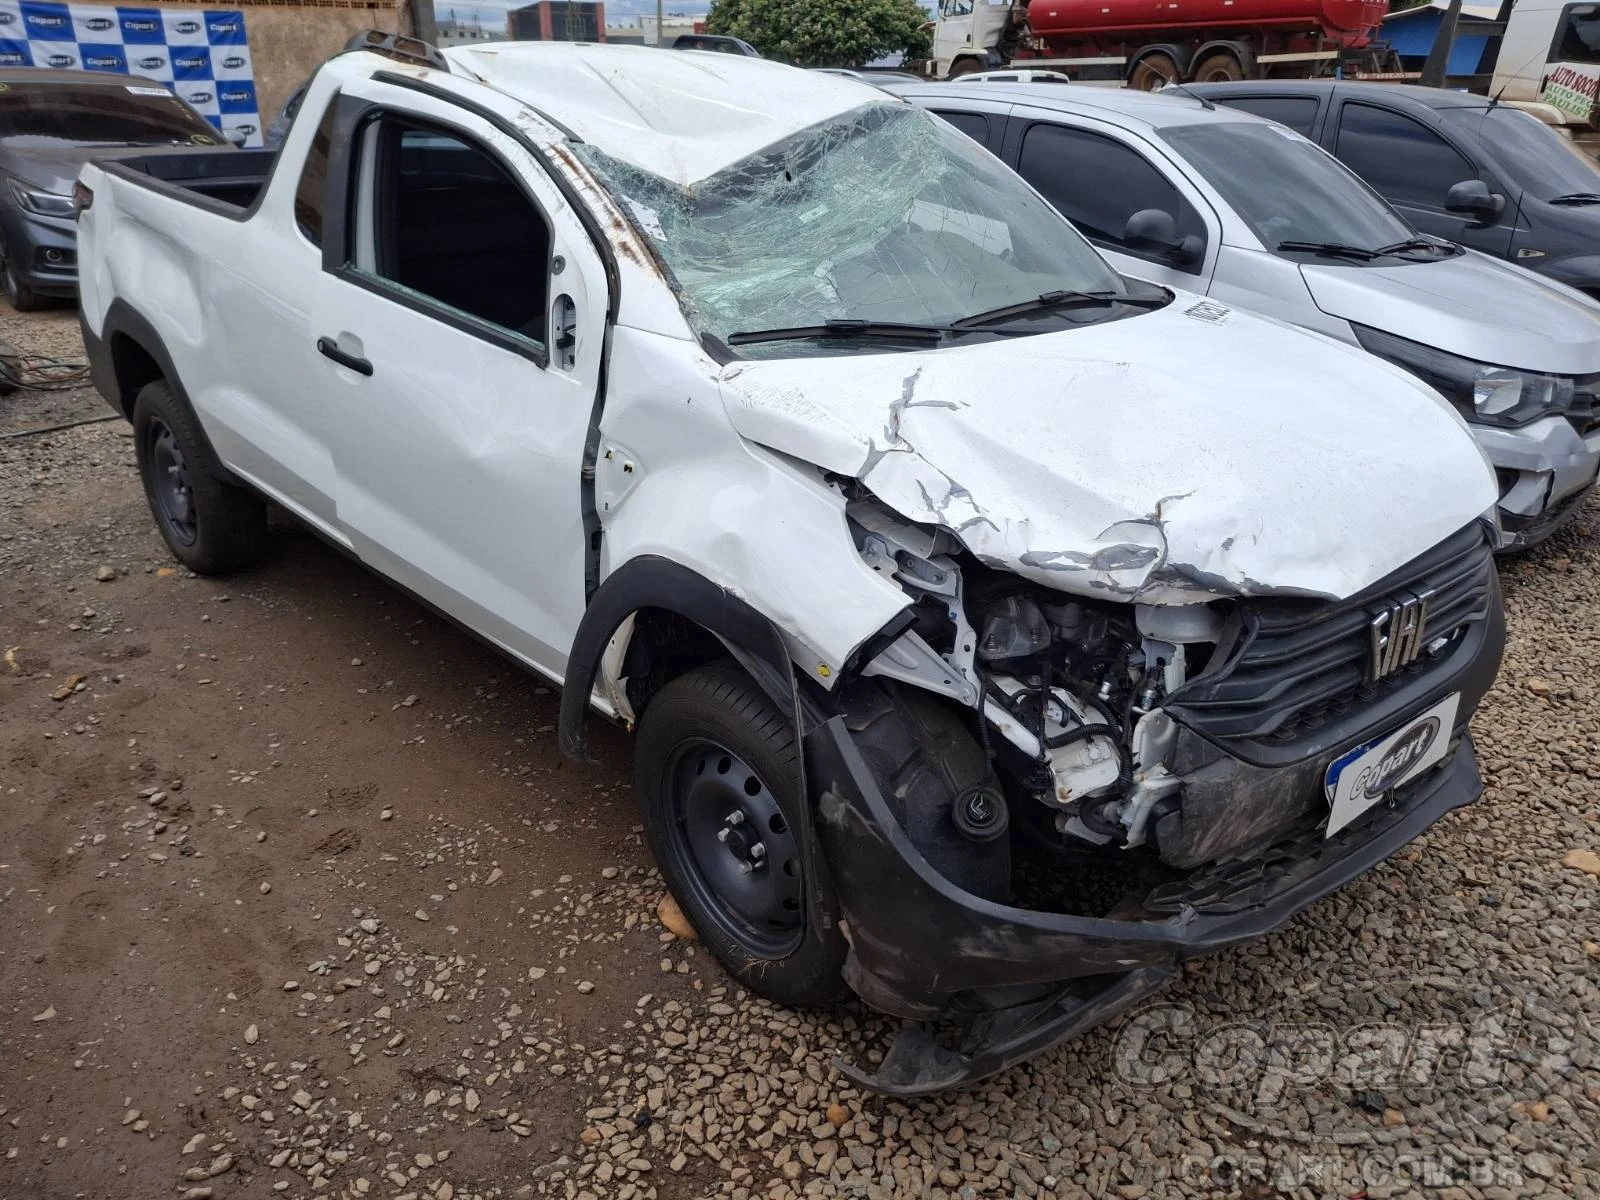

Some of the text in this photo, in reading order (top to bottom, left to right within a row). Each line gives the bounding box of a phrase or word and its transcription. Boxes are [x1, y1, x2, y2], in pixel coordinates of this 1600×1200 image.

[28, 15, 62, 25] Copart
[124, 21, 155, 30] Copart
[87, 57, 118, 66] Copart
[1547, 66, 1576, 88] AUTO
[221, 92, 248, 102] Copart
[1546, 84, 1573, 99] AUTO
[1371, 589, 1435, 682] FIAT
[1350, 726, 1431, 800] Copart
